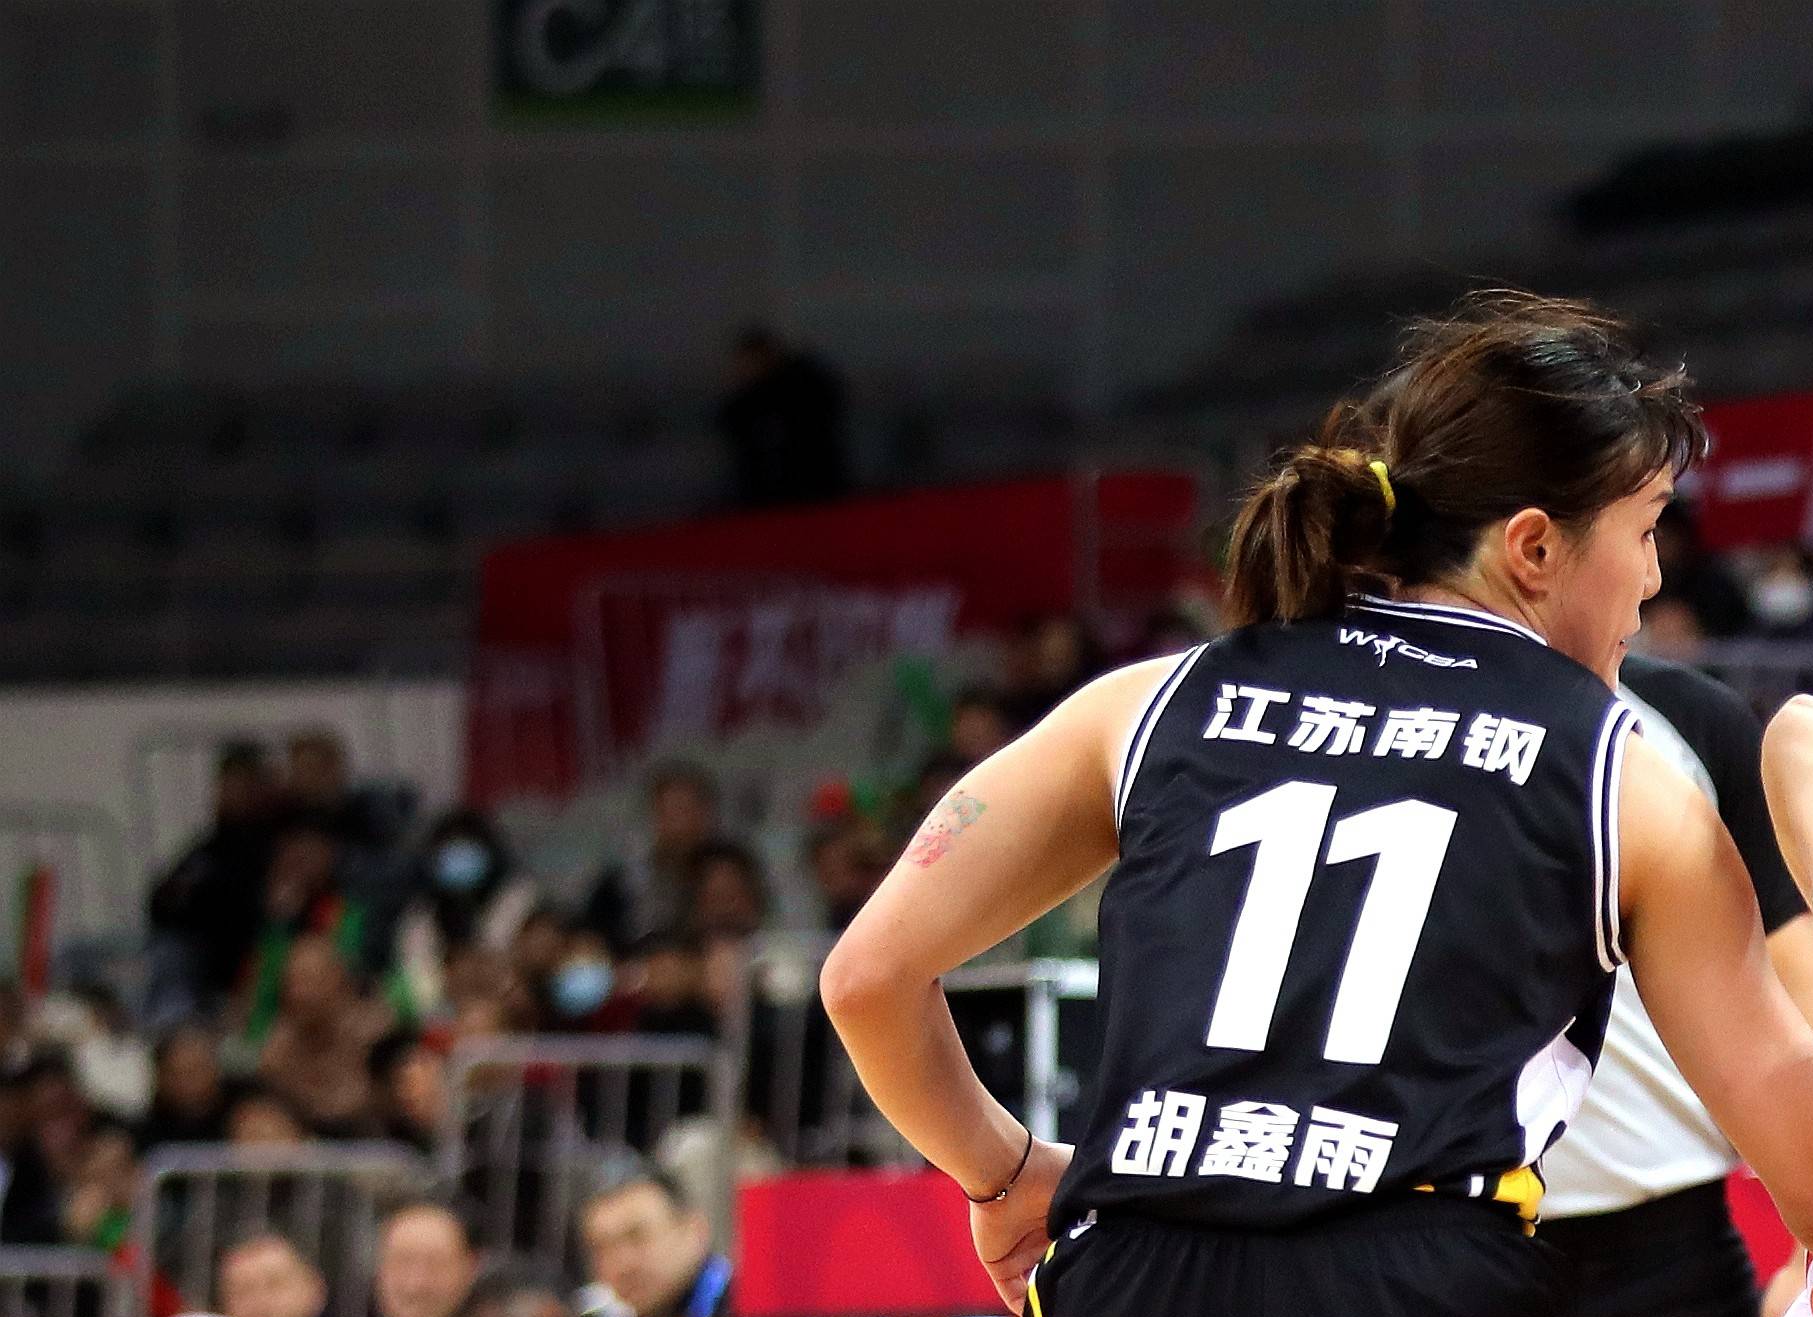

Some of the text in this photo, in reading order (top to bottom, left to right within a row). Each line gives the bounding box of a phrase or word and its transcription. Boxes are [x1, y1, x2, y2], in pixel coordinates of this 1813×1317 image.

[1339, 628, 1478, 668] WCBA
[1203, 684, 1547, 786] 江苏南钢
[1206, 780, 1459, 1065] 11
[1111, 1090, 1399, 1194] 胡鑫雨
